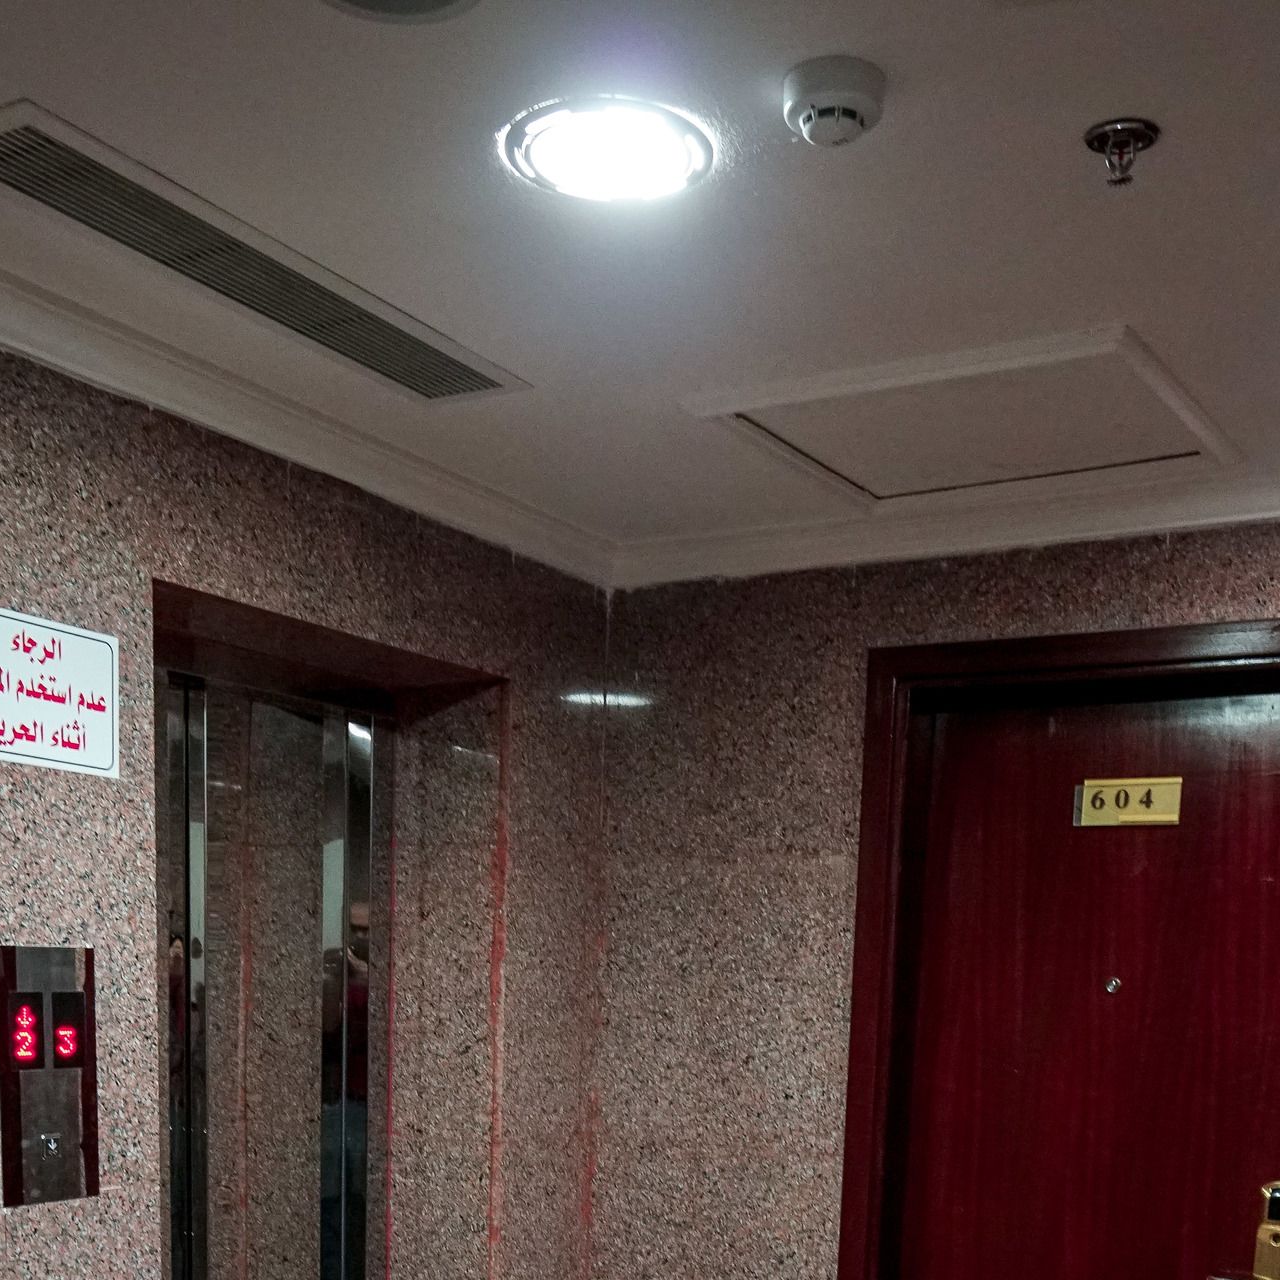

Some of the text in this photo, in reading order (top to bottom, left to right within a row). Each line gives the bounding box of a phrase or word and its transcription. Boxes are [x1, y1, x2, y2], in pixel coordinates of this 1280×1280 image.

[11, 630, 62, 664] الرجاء
[78, 691, 107, 714] عدم
[1090, 788, 1154, 810] 604
[15, 1030, 35, 1059] 2
[57, 1027, 76, 1057] 3
